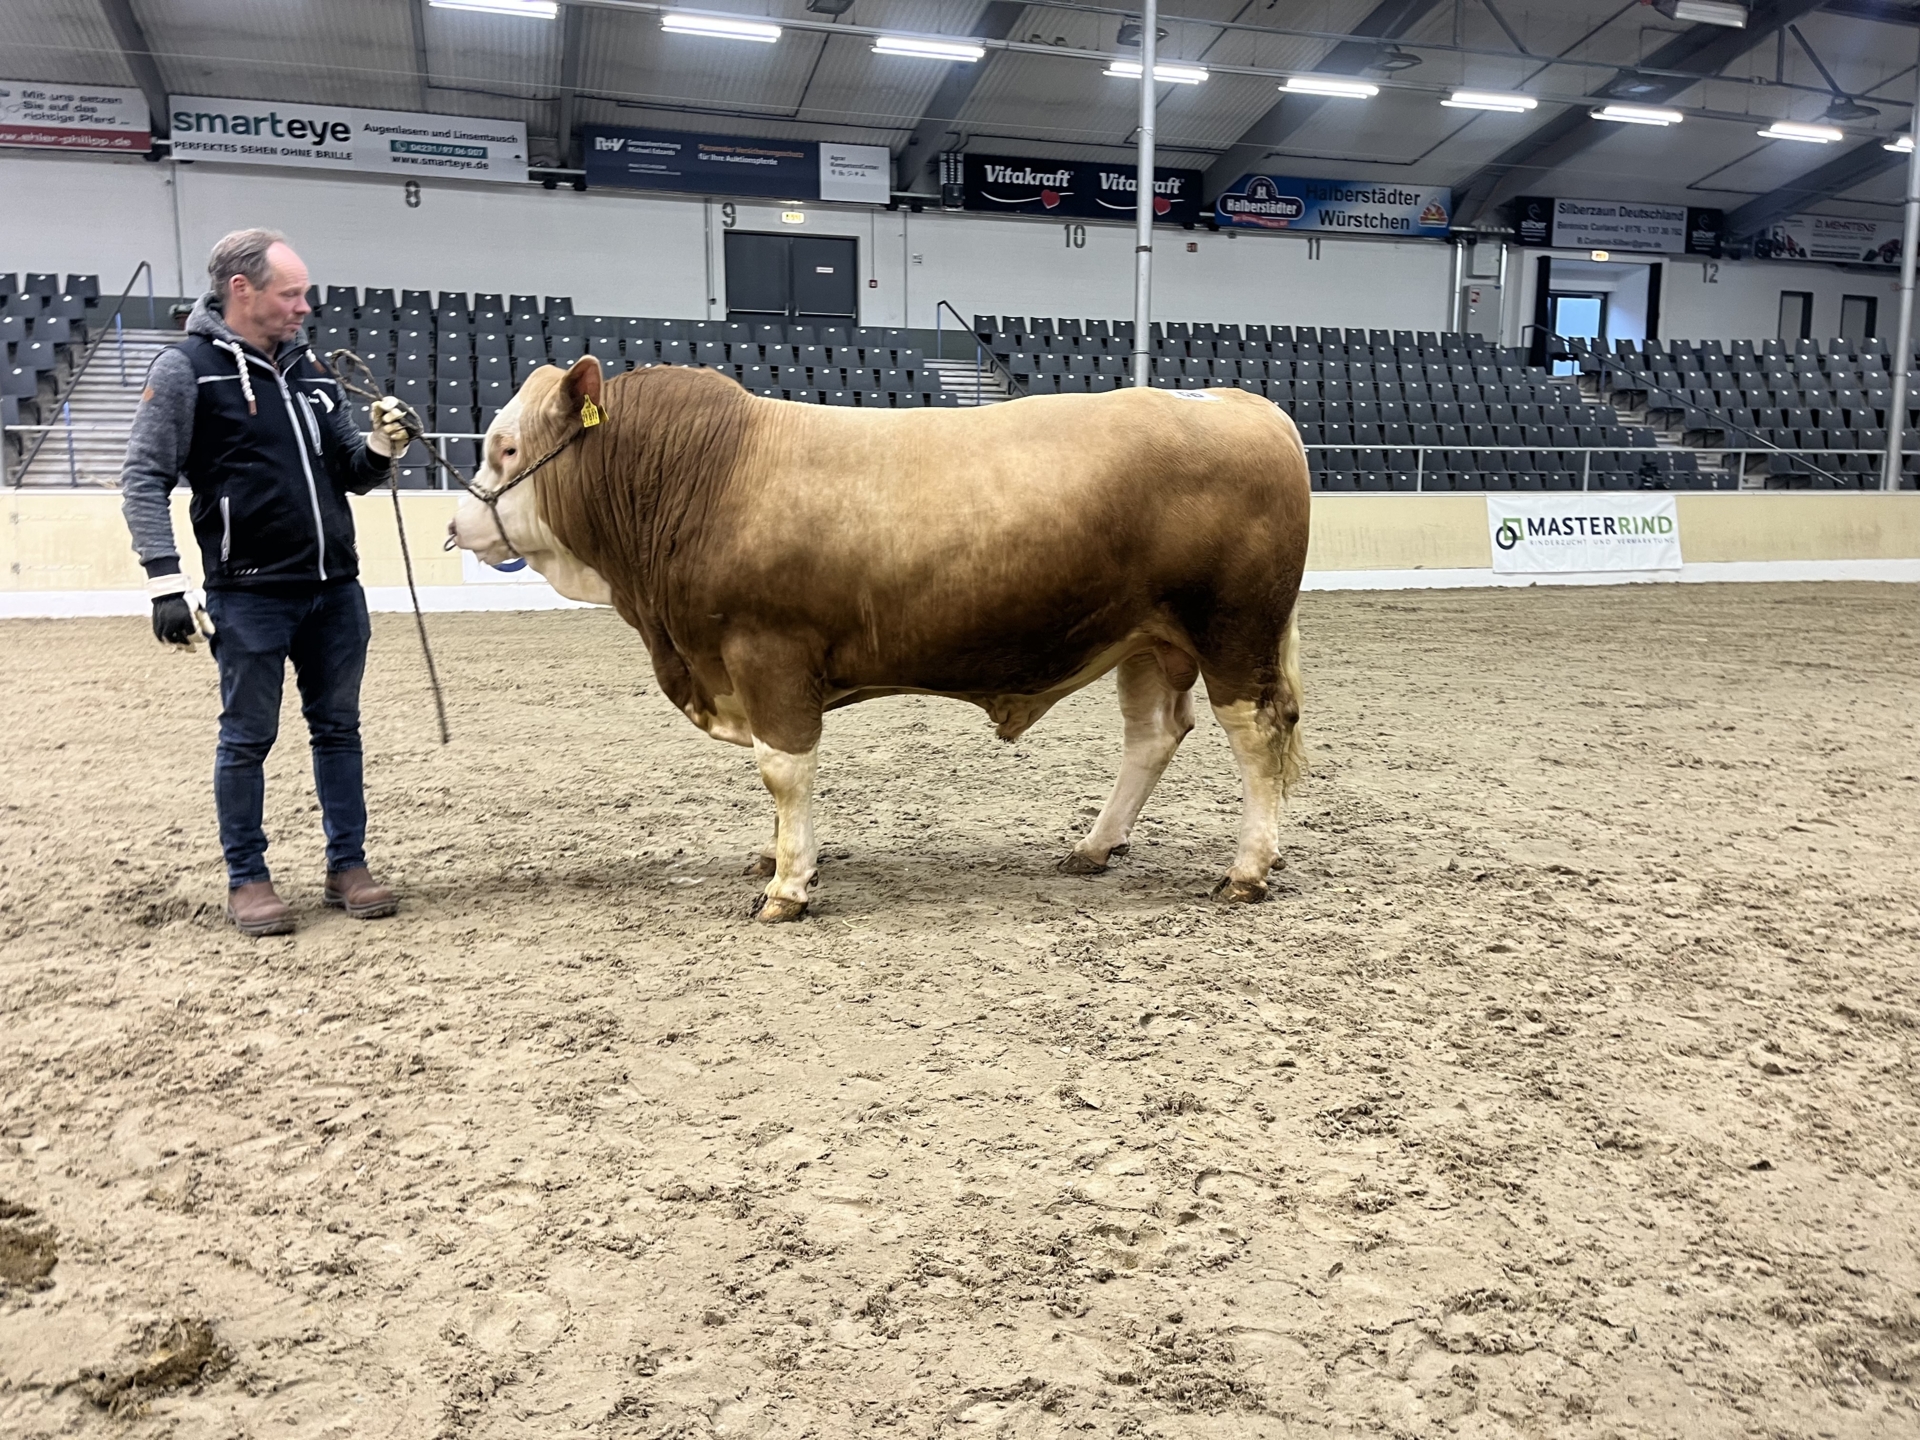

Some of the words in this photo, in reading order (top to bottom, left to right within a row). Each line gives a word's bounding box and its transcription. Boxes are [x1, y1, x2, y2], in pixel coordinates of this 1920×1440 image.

[22, 90, 45, 100] Mit
[50, 93, 75, 101] uns
[79, 96, 122, 104] setzen
[22, 101, 44, 110] Sie
[48, 103, 69, 111] auf
[73, 104, 98, 113] das
[23, 112, 75, 123] richtige
[79, 114, 116, 125] Pferd
[173, 111, 352, 146] smarteye
[363, 123, 430, 136] Augenlasern
[431, 129, 451, 138] und
[453, 130, 518, 144] Linsentausch
[174, 141, 238, 153] PERFEKTES
[239, 145, 278, 155] SEHEN
[280, 147, 313, 158] OHNE
[315, 150, 353, 160] BRILLE
[698, 152, 710, 160] für
[392, 156, 490, 170] www.smarteye.de
[984, 165, 1071, 187] Vitakraft
[1099, 172, 1181, 194] Vitaaft
[405, 180, 421, 208] 8
[1254, 186, 1269, 199] H
[1305, 183, 1421, 206] Halberstädter
[722, 202, 736, 228] 9
[1226, 198, 1298, 215] Halberstädter
[1558, 202, 1616, 217] Silberzaun
[1619, 206, 1684, 222] Deutschland
[1318, 208, 1410, 230] Würstchen
[1064, 223, 1086, 249] 10
[1307, 238, 1321, 261] 11
[1702, 262, 1719, 284] 12
[1527, 516, 1673, 536] MASTERRIND
[1529, 539, 1587, 547] RINDERZUCHT
[1593, 538, 1612, 546] UND
[1617, 537, 1676, 546] VERMARKTUNG
